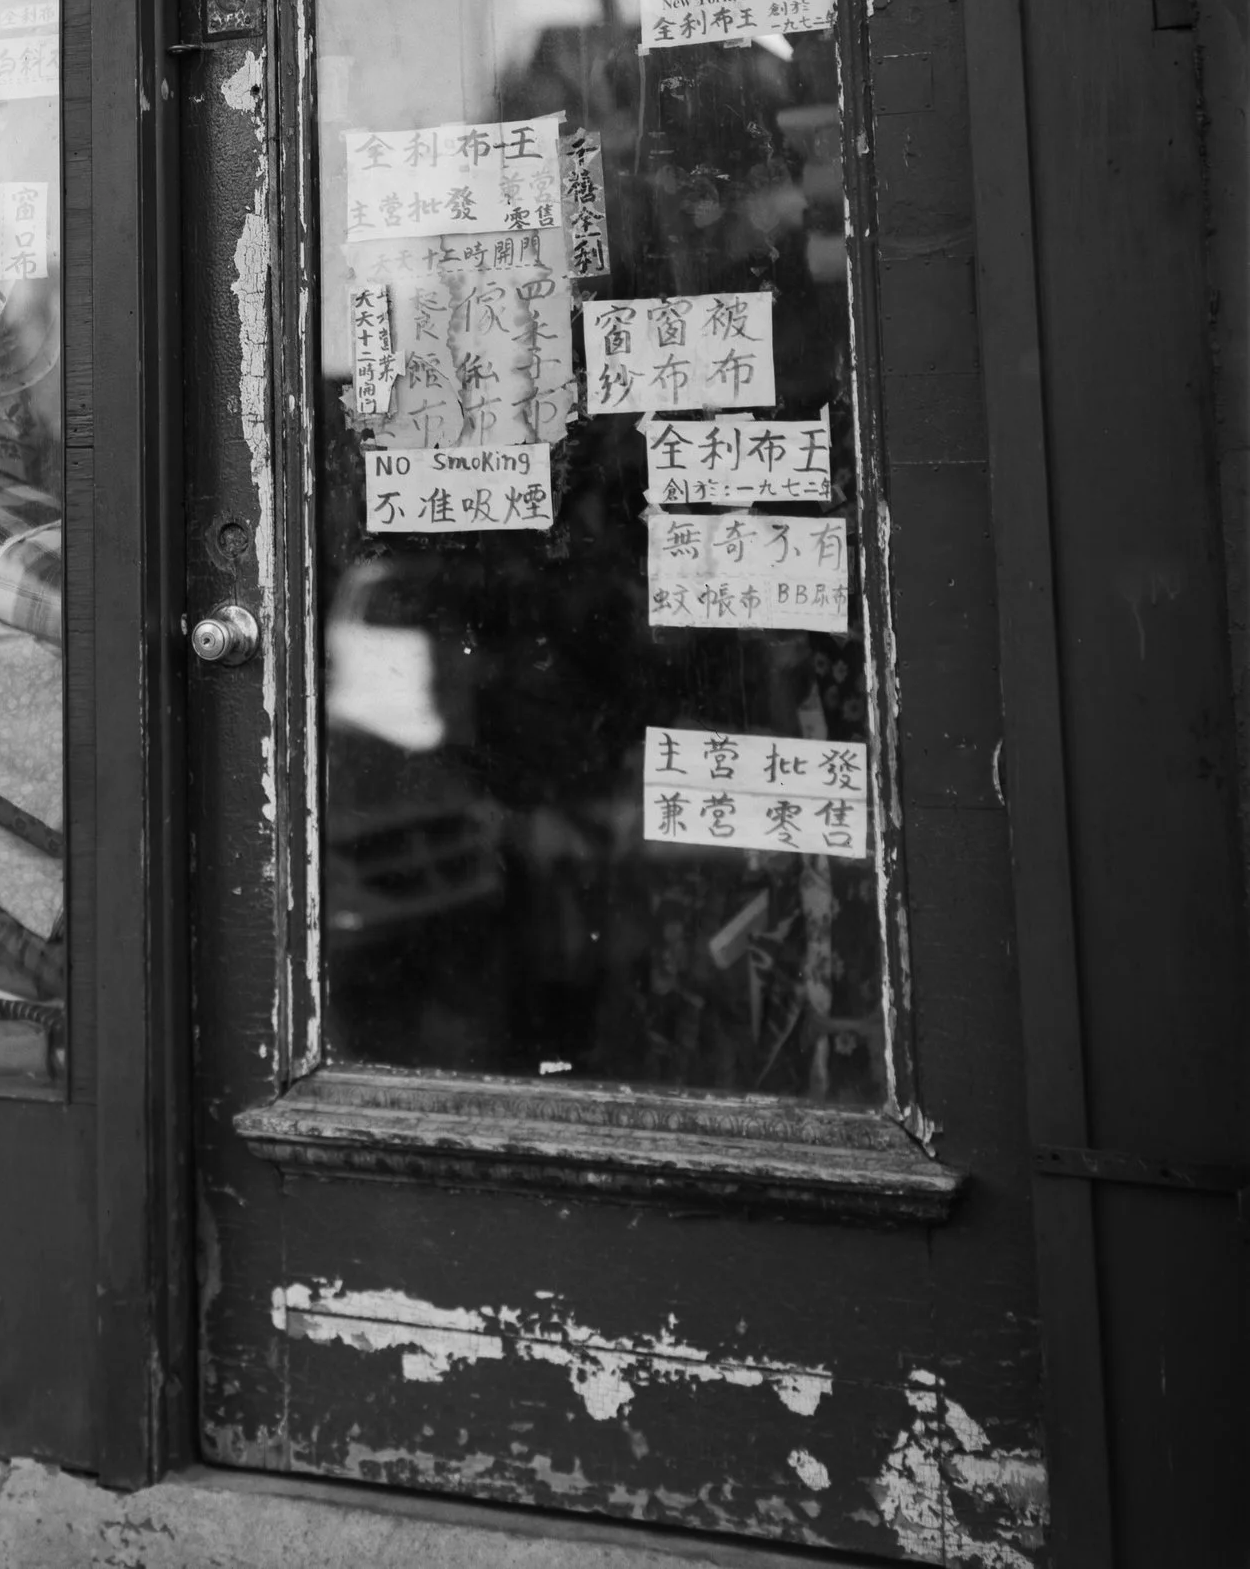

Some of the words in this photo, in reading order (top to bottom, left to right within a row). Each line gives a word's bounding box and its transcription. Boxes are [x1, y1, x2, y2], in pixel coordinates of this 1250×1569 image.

[653, 6, 758, 42] 全利布王
[354, 126, 543, 171] 全利布王
[375, 455, 411, 477] NO
[651, 424, 829, 474] 全利布王
[374, 483, 551, 524] 不准吸煙
[663, 519, 843, 572] 無奇不有
[655, 732, 862, 791] 主營批發
[654, 791, 854, 849] 兼營零售
